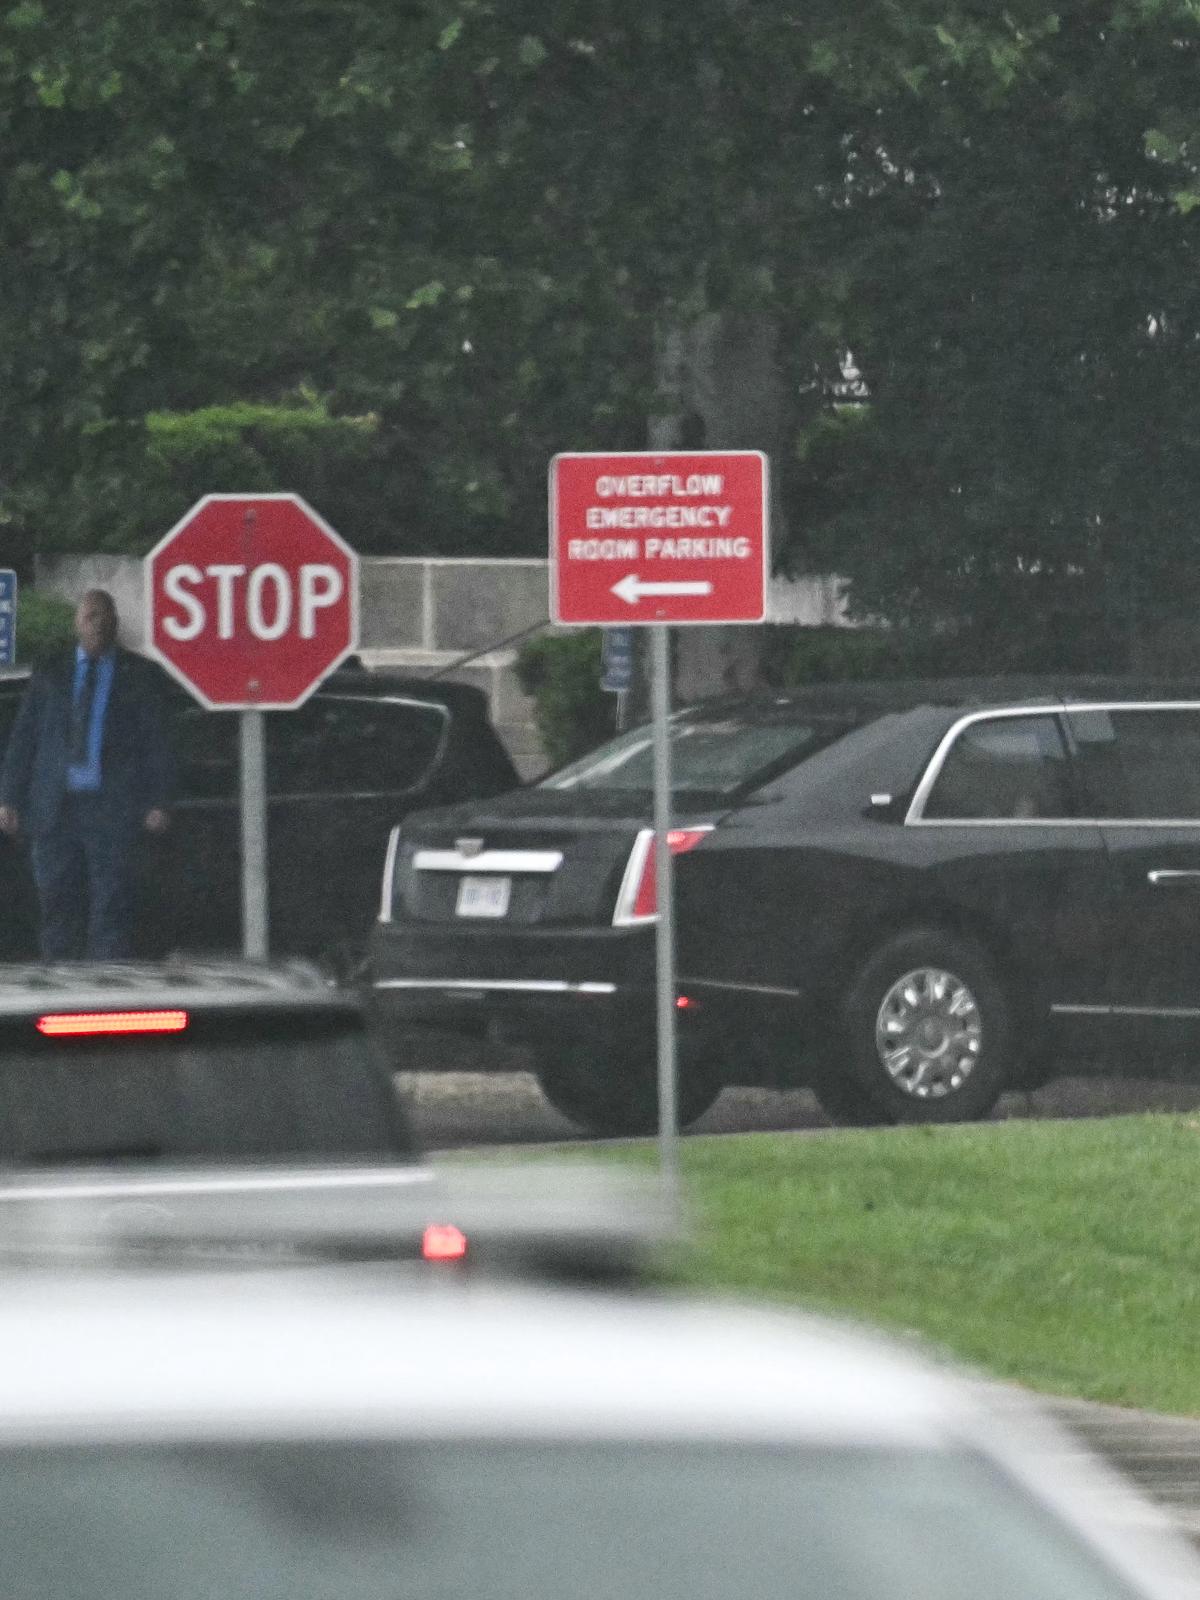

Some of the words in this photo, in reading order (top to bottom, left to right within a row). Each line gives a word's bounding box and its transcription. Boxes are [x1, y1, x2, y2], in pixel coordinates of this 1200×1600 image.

[596, 474, 723, 496] OVERFLOW
[586, 506, 731, 529] EMERGENCY
[567, 538, 640, 560] ROOM
[644, 537, 750, 560] PARKING
[162, 563, 344, 641] STOP
